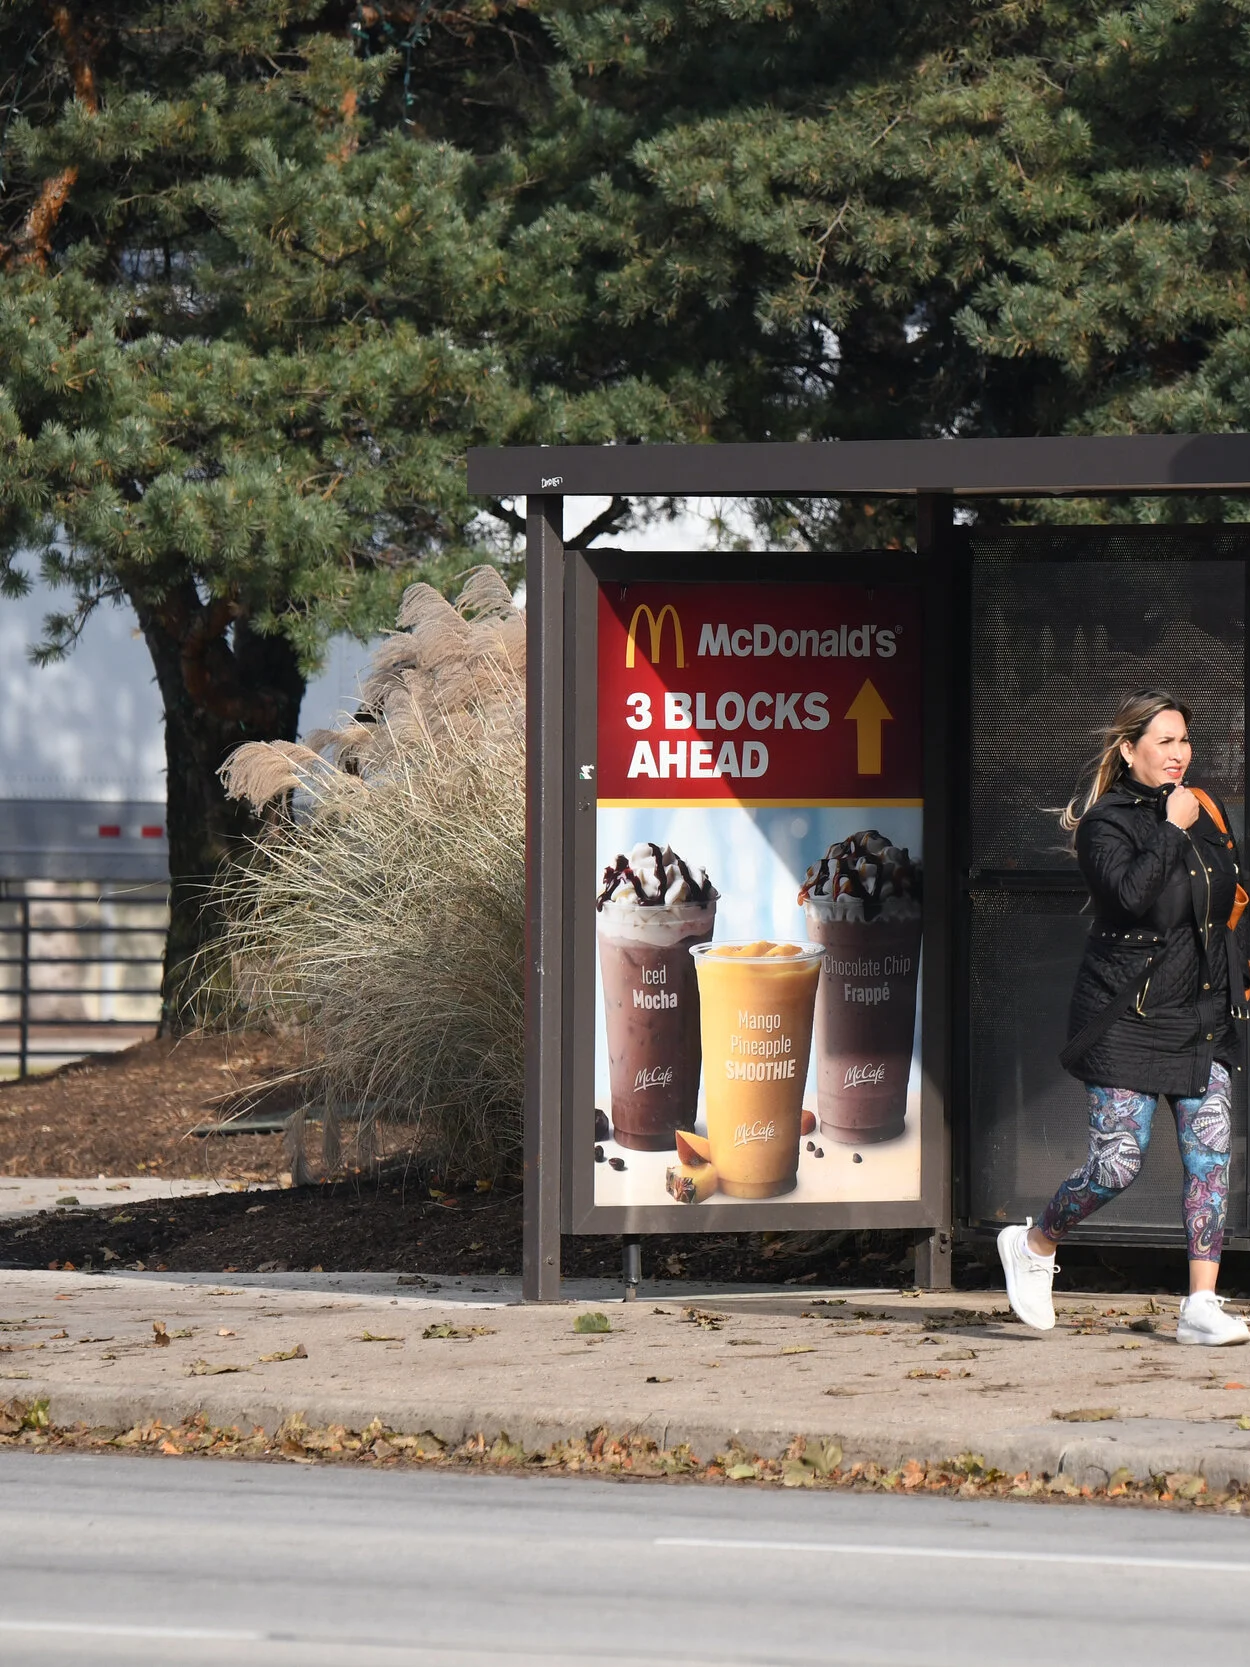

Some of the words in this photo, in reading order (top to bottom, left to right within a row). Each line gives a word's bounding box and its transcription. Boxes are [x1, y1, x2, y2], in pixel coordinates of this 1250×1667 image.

[697, 623, 897, 658] McDonald's
[625, 692, 653, 731] 3
[665, 691, 831, 731] BLOCKS
[627, 741, 769, 779] AHEAD
[641, 965, 667, 985] Iced
[823, 953, 880, 977] Chocolate
[884, 953, 911, 977] Chip
[632, 988, 678, 1010] Mocha
[844, 981, 890, 1006] Frappé
[738, 1010, 781, 1033] Mango
[730, 1034, 792, 1058] Pineapple
[634, 1066, 673, 1091] McCafé
[724, 1058, 796, 1082] SMOOTHIE
[843, 1063, 886, 1090] McCafé
[733, 1120, 776, 1147] McCafé
